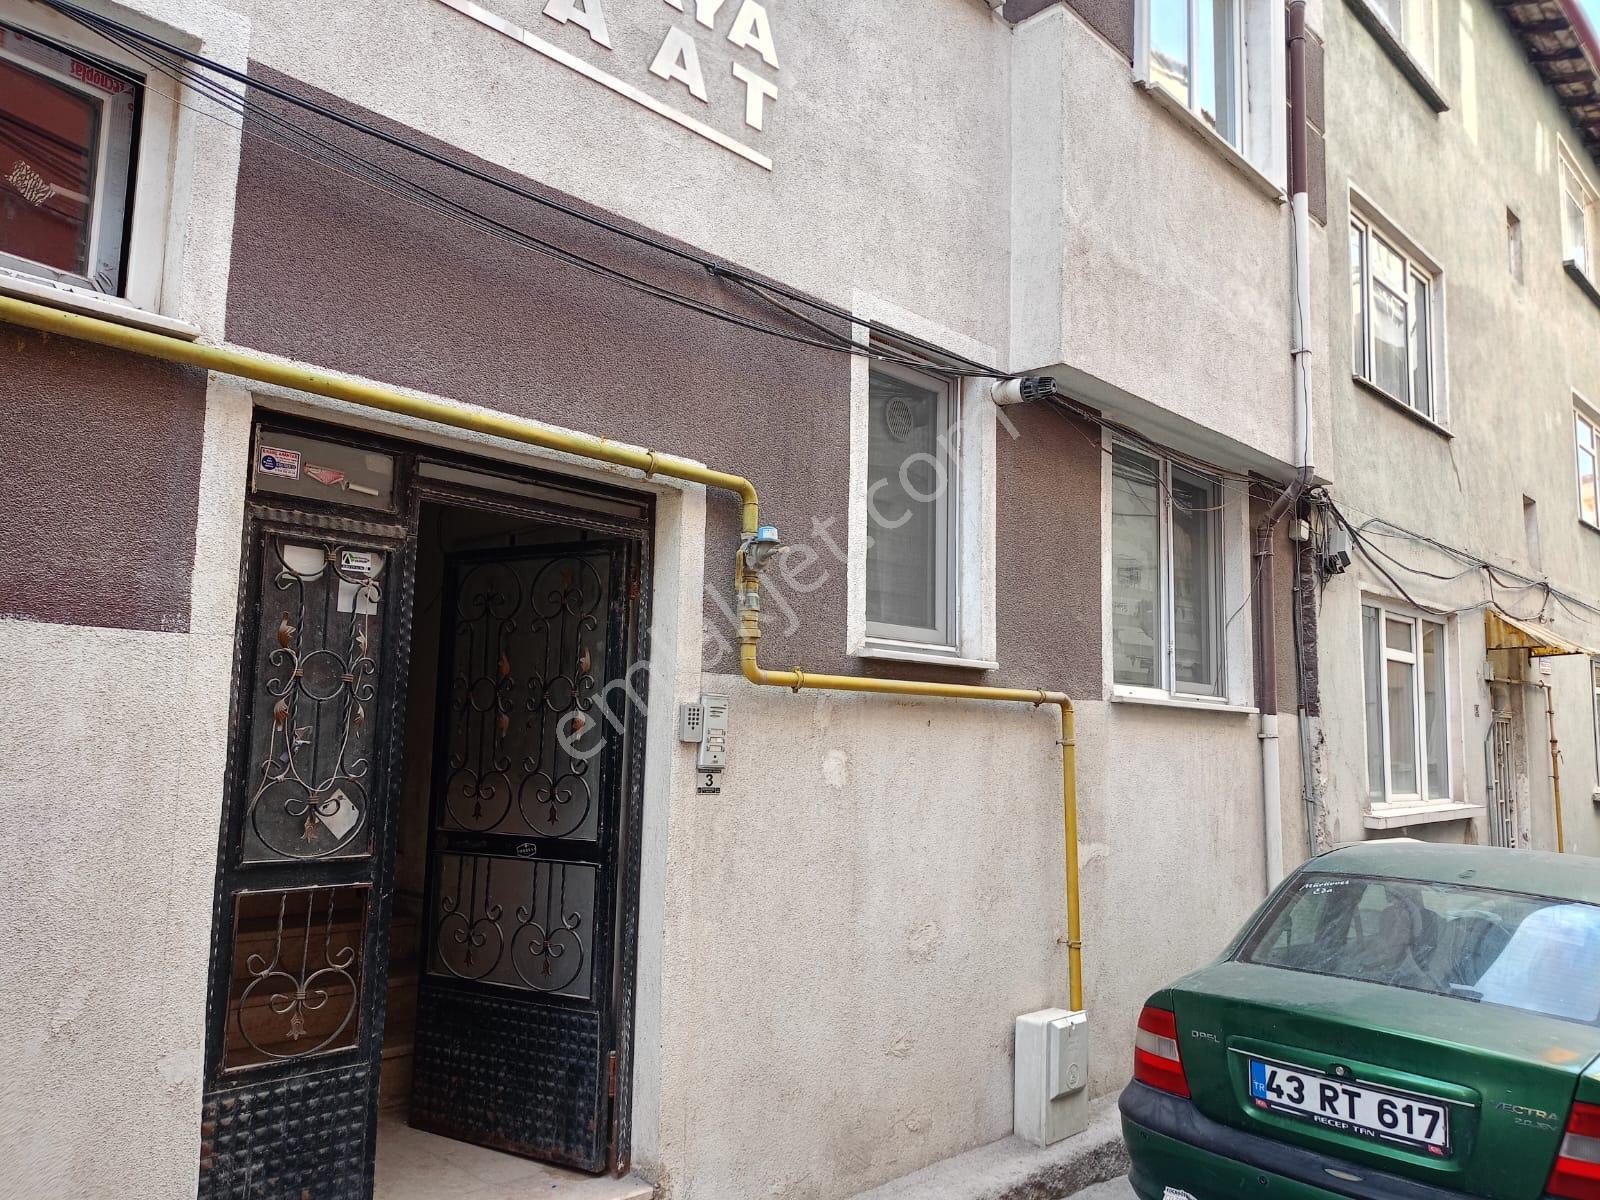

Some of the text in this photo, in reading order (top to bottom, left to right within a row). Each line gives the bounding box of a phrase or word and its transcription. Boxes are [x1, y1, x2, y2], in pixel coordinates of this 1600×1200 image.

[663, 0, 780, 70] YA
[704, 773, 714, 787] 3
[1191, 1029, 1220, 1043] OPEL
[1253, 1081, 1266, 1092] TR
[1266, 1069, 1441, 1140] 43 RT 617
[1313, 1115, 1349, 1129] RECEP
